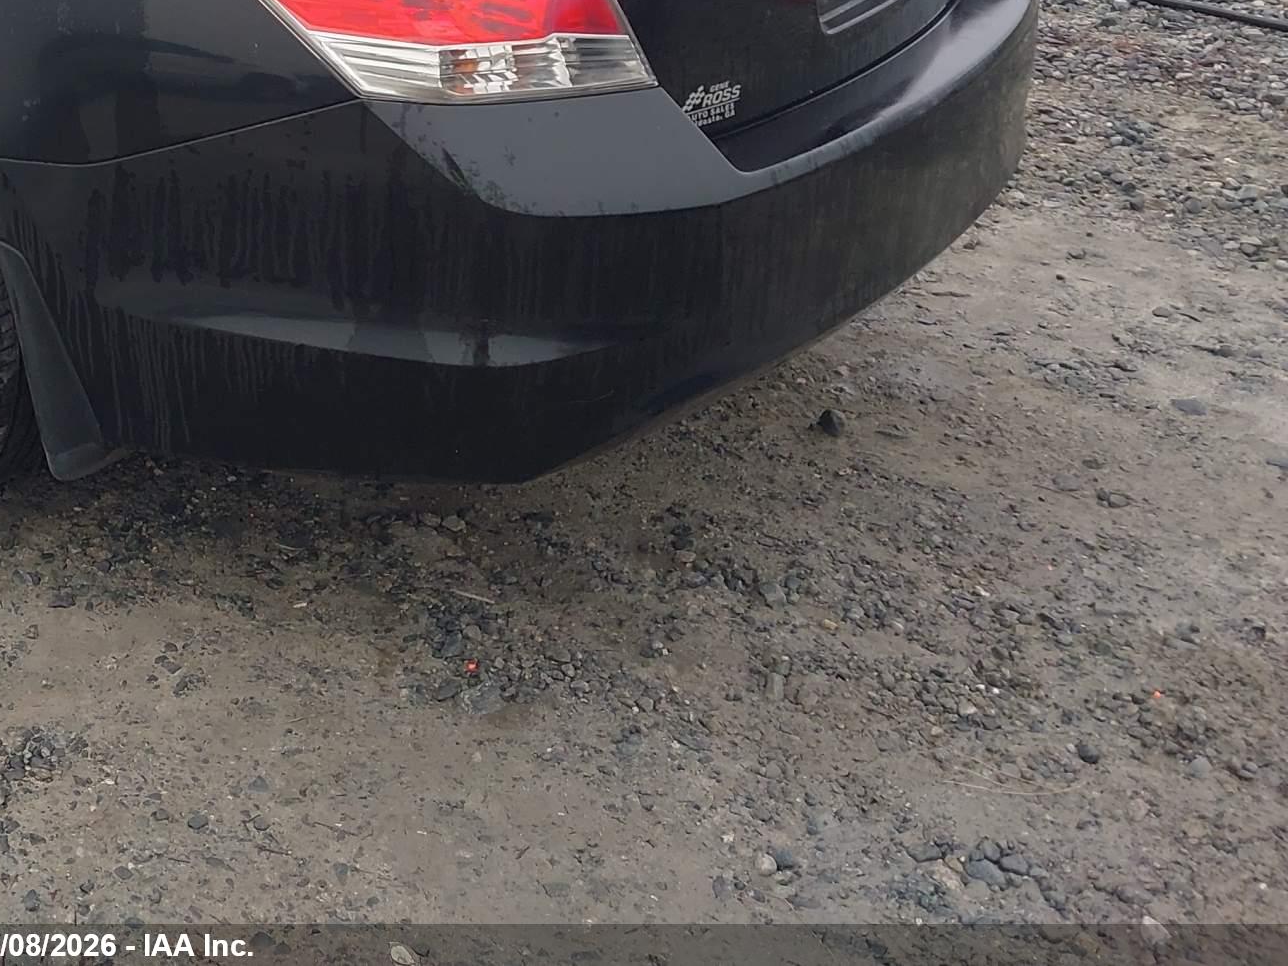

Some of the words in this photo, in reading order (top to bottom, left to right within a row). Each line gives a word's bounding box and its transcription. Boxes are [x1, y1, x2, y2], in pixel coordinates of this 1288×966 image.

[702, 85, 741, 107] ROSS
[688, 110, 709, 122] UTO
[711, 102, 735, 116] SALES
